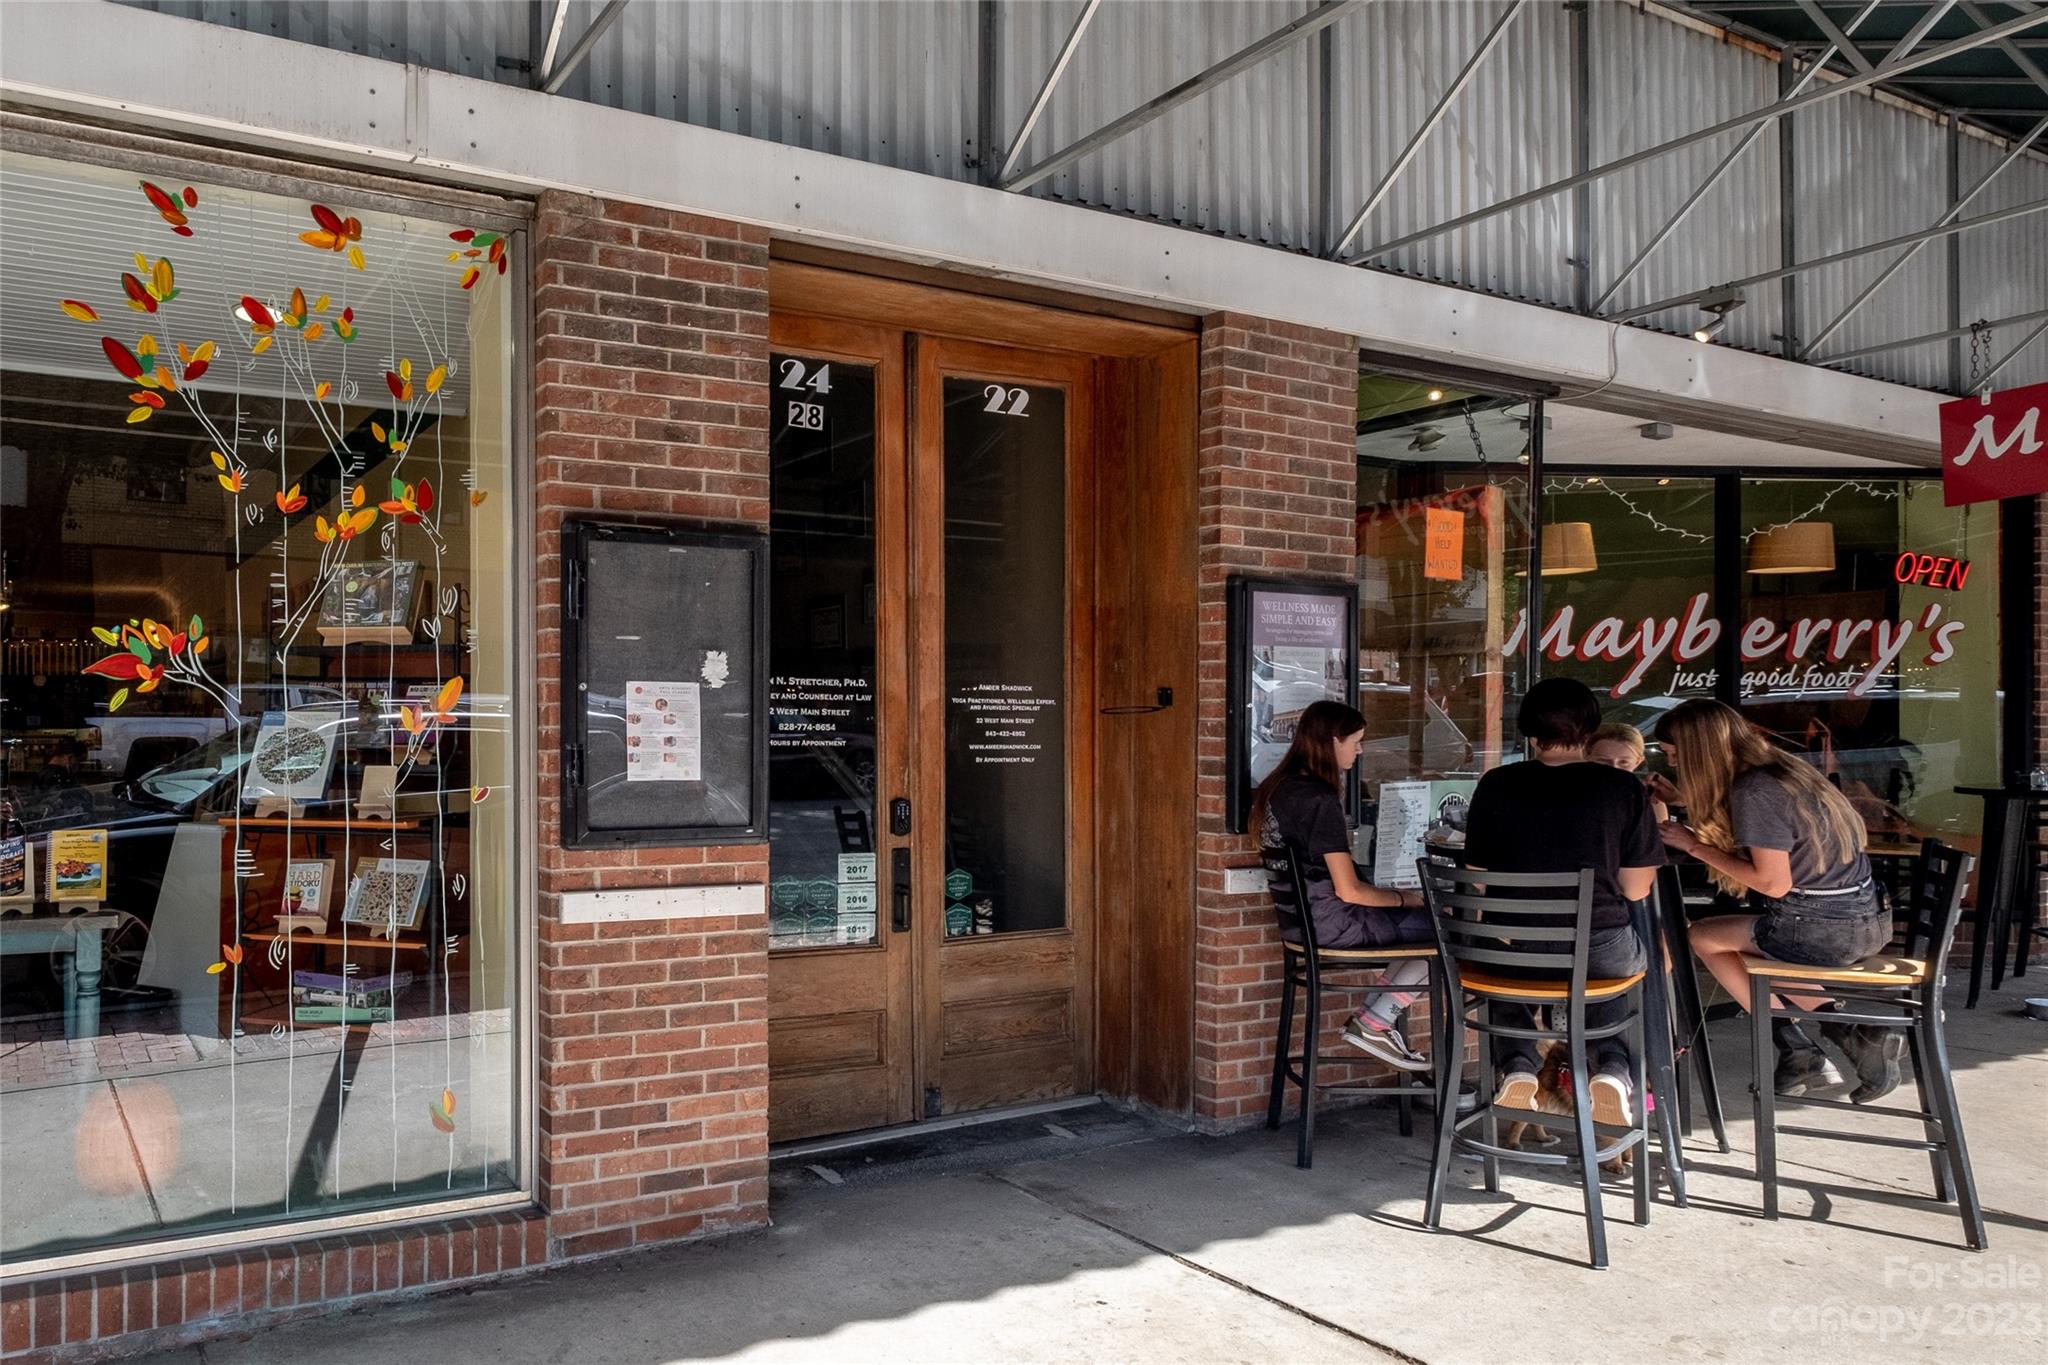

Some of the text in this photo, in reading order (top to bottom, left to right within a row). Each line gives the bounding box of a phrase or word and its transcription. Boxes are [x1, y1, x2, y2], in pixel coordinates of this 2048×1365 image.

[779, 359, 833, 394] 24
[984, 384, 1030, 417] 22
[789, 402, 823, 429] 28
[1953, 407, 2044, 466] M
[1895, 551, 1971, 590] OPEN
[1262, 601, 1337, 614] WELLNESS MADE
[1261, 613, 1337, 627] SIMPLE AND EASY
[1501, 592, 1965, 698] Mayberry's
[1663, 664, 1858, 700] just good food
[798, 692, 844, 701] COUNSELOR
[776, 707, 799, 716] WEST
[800, 708, 820, 716] MAIN
[821, 708, 851, 716] STREET
[801, 739, 847, 747] APPOINTMENT
[846, 865, 868, 874] 2017
[286, 880, 320, 888] UDOKU
[846, 895, 868, 903] 2016
